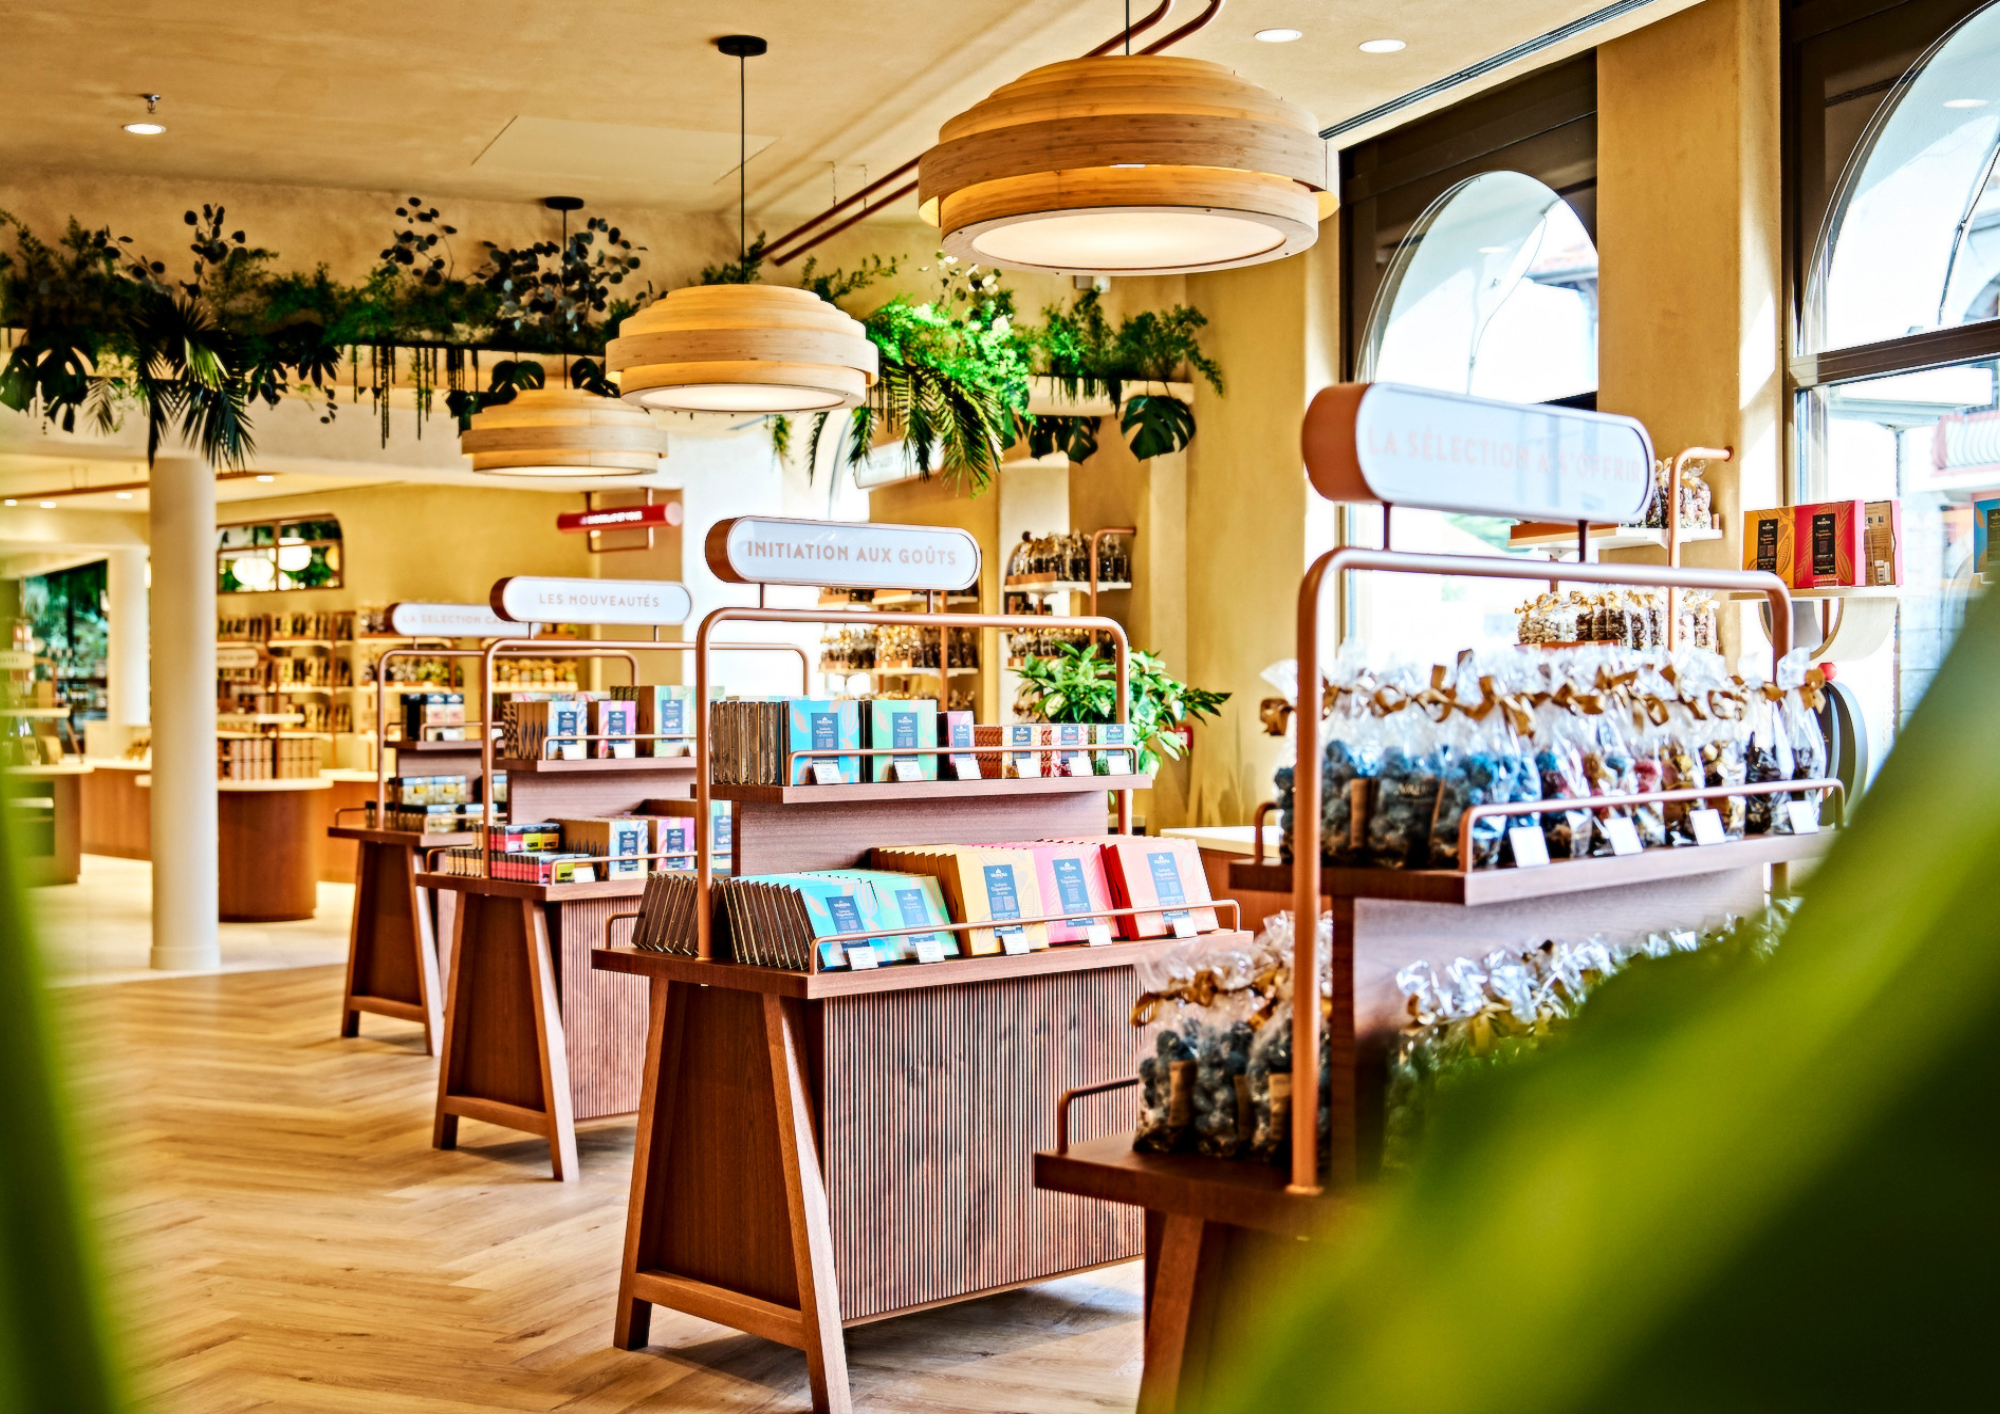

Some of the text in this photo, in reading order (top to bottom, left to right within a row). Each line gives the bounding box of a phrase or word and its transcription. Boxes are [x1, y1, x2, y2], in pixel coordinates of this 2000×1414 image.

[1368, 427, 1399, 456] LA
[1407, 423, 1531, 470] SÉLECTION
[747, 540, 957, 566] INITIATION AUX GOÛTS
[539, 593, 660, 608] LES NOUVEAUTÉS
[402, 613, 416, 623] LA
